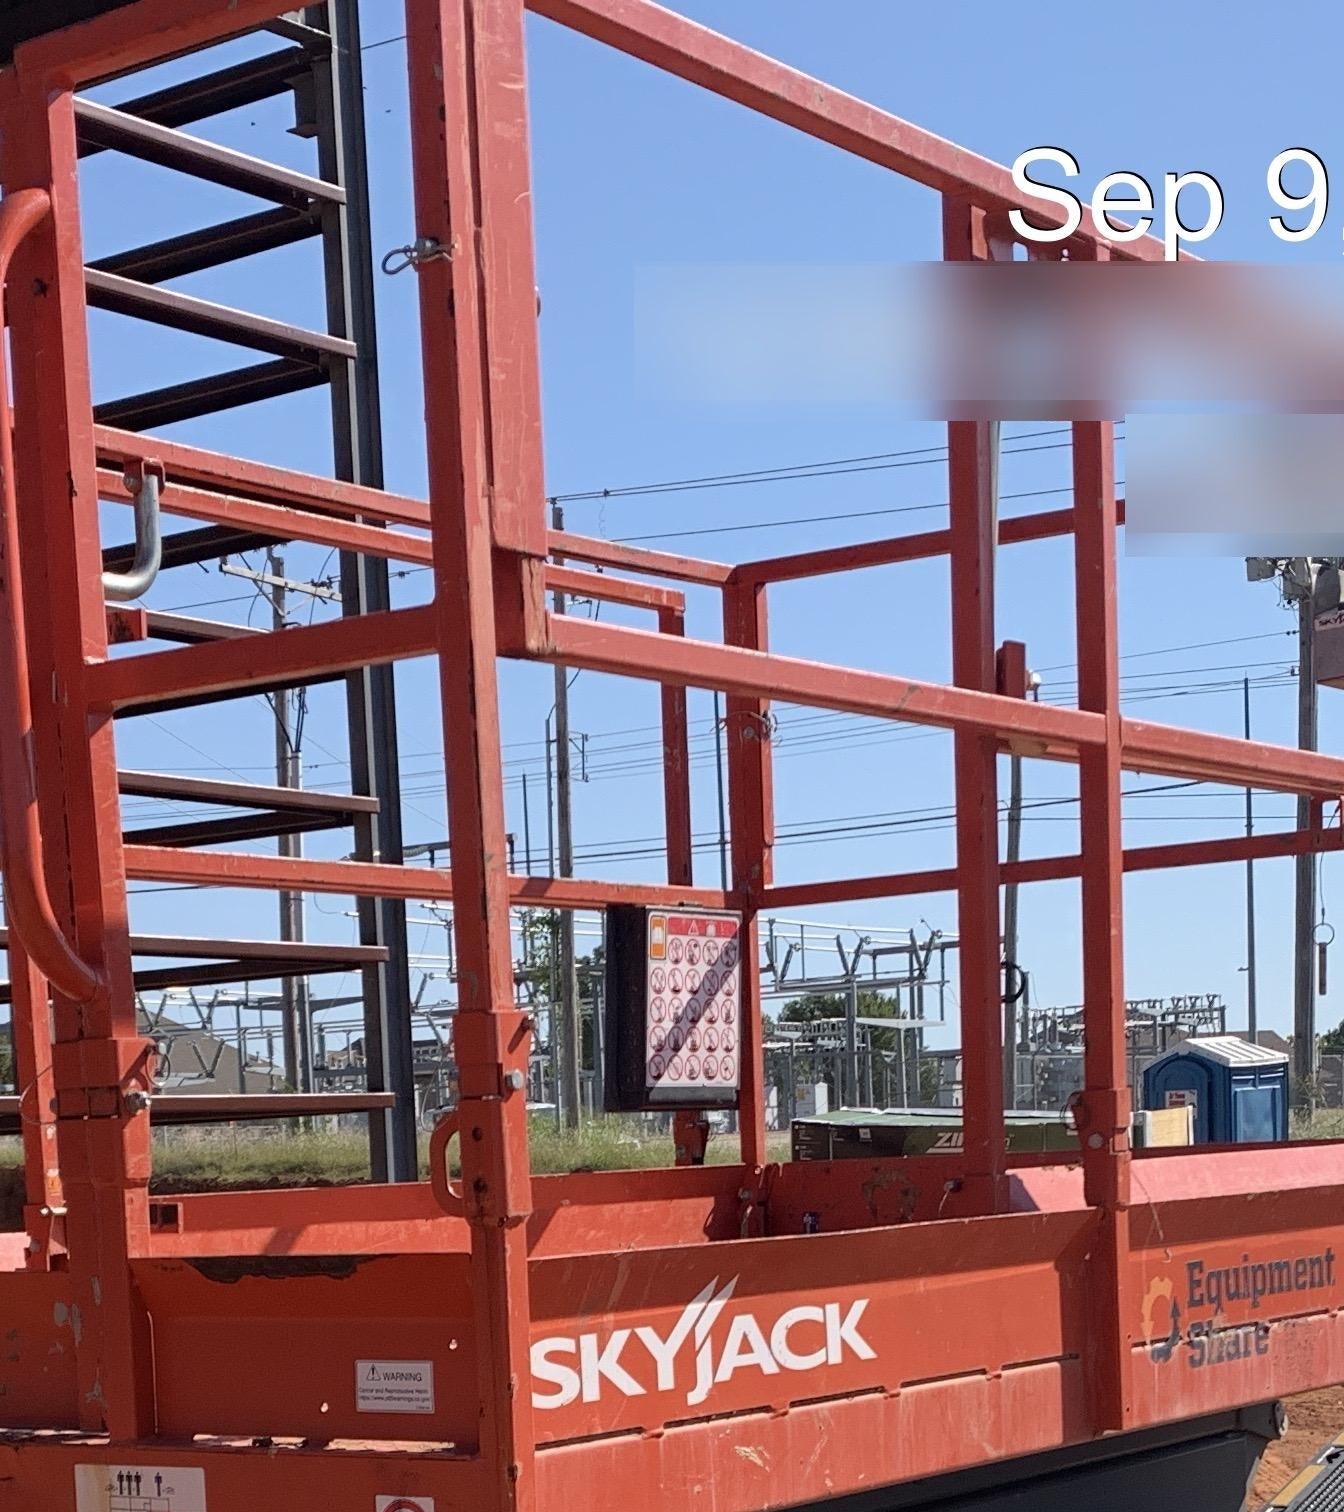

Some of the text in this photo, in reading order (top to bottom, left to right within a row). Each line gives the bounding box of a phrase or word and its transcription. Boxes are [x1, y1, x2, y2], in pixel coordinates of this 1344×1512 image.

[1187, 1248, 1336, 1316] Equipment
[530, 1275, 877, 1409] SKYJACK
[1188, 1320, 1270, 1368] Share
[382, 1371, 423, 1382] WARNING
